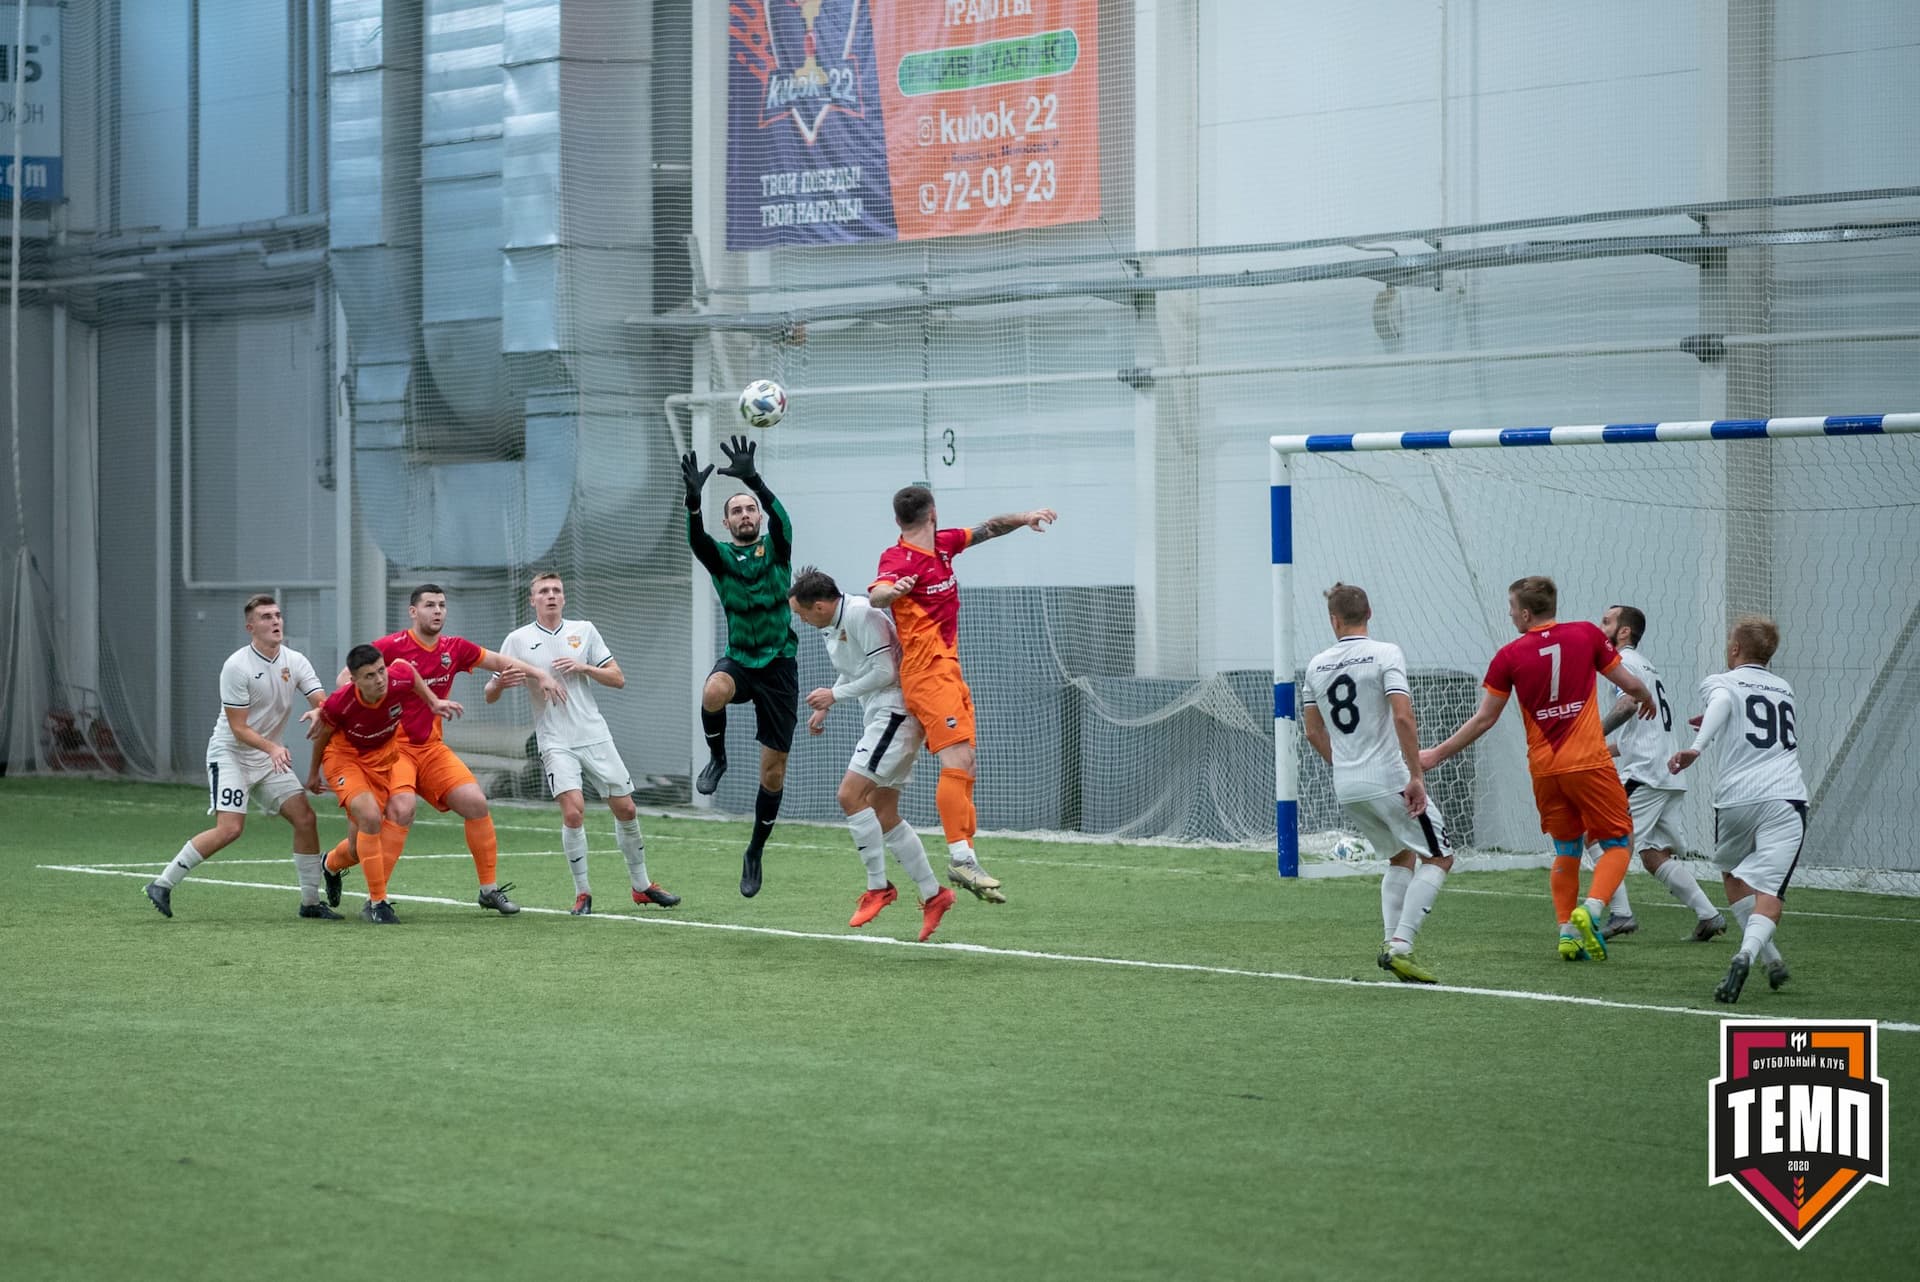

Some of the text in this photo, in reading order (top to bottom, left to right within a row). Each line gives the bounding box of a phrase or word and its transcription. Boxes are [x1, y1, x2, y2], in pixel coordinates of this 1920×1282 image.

[760, 173, 797, 197] ТВОИ
[943, 159, 1057, 212] 72-03-23
[760, 203, 794, 227] ТВОИ
[942, 427, 956, 467] 3
[1539, 643, 1561, 702] 7
[1327, 673, 1360, 735] 8
[1536, 701, 1584, 721] SEUS
[1655, 679, 1672, 733] 6
[1745, 694, 1798, 751] 96
[220, 787, 244, 807] 98
